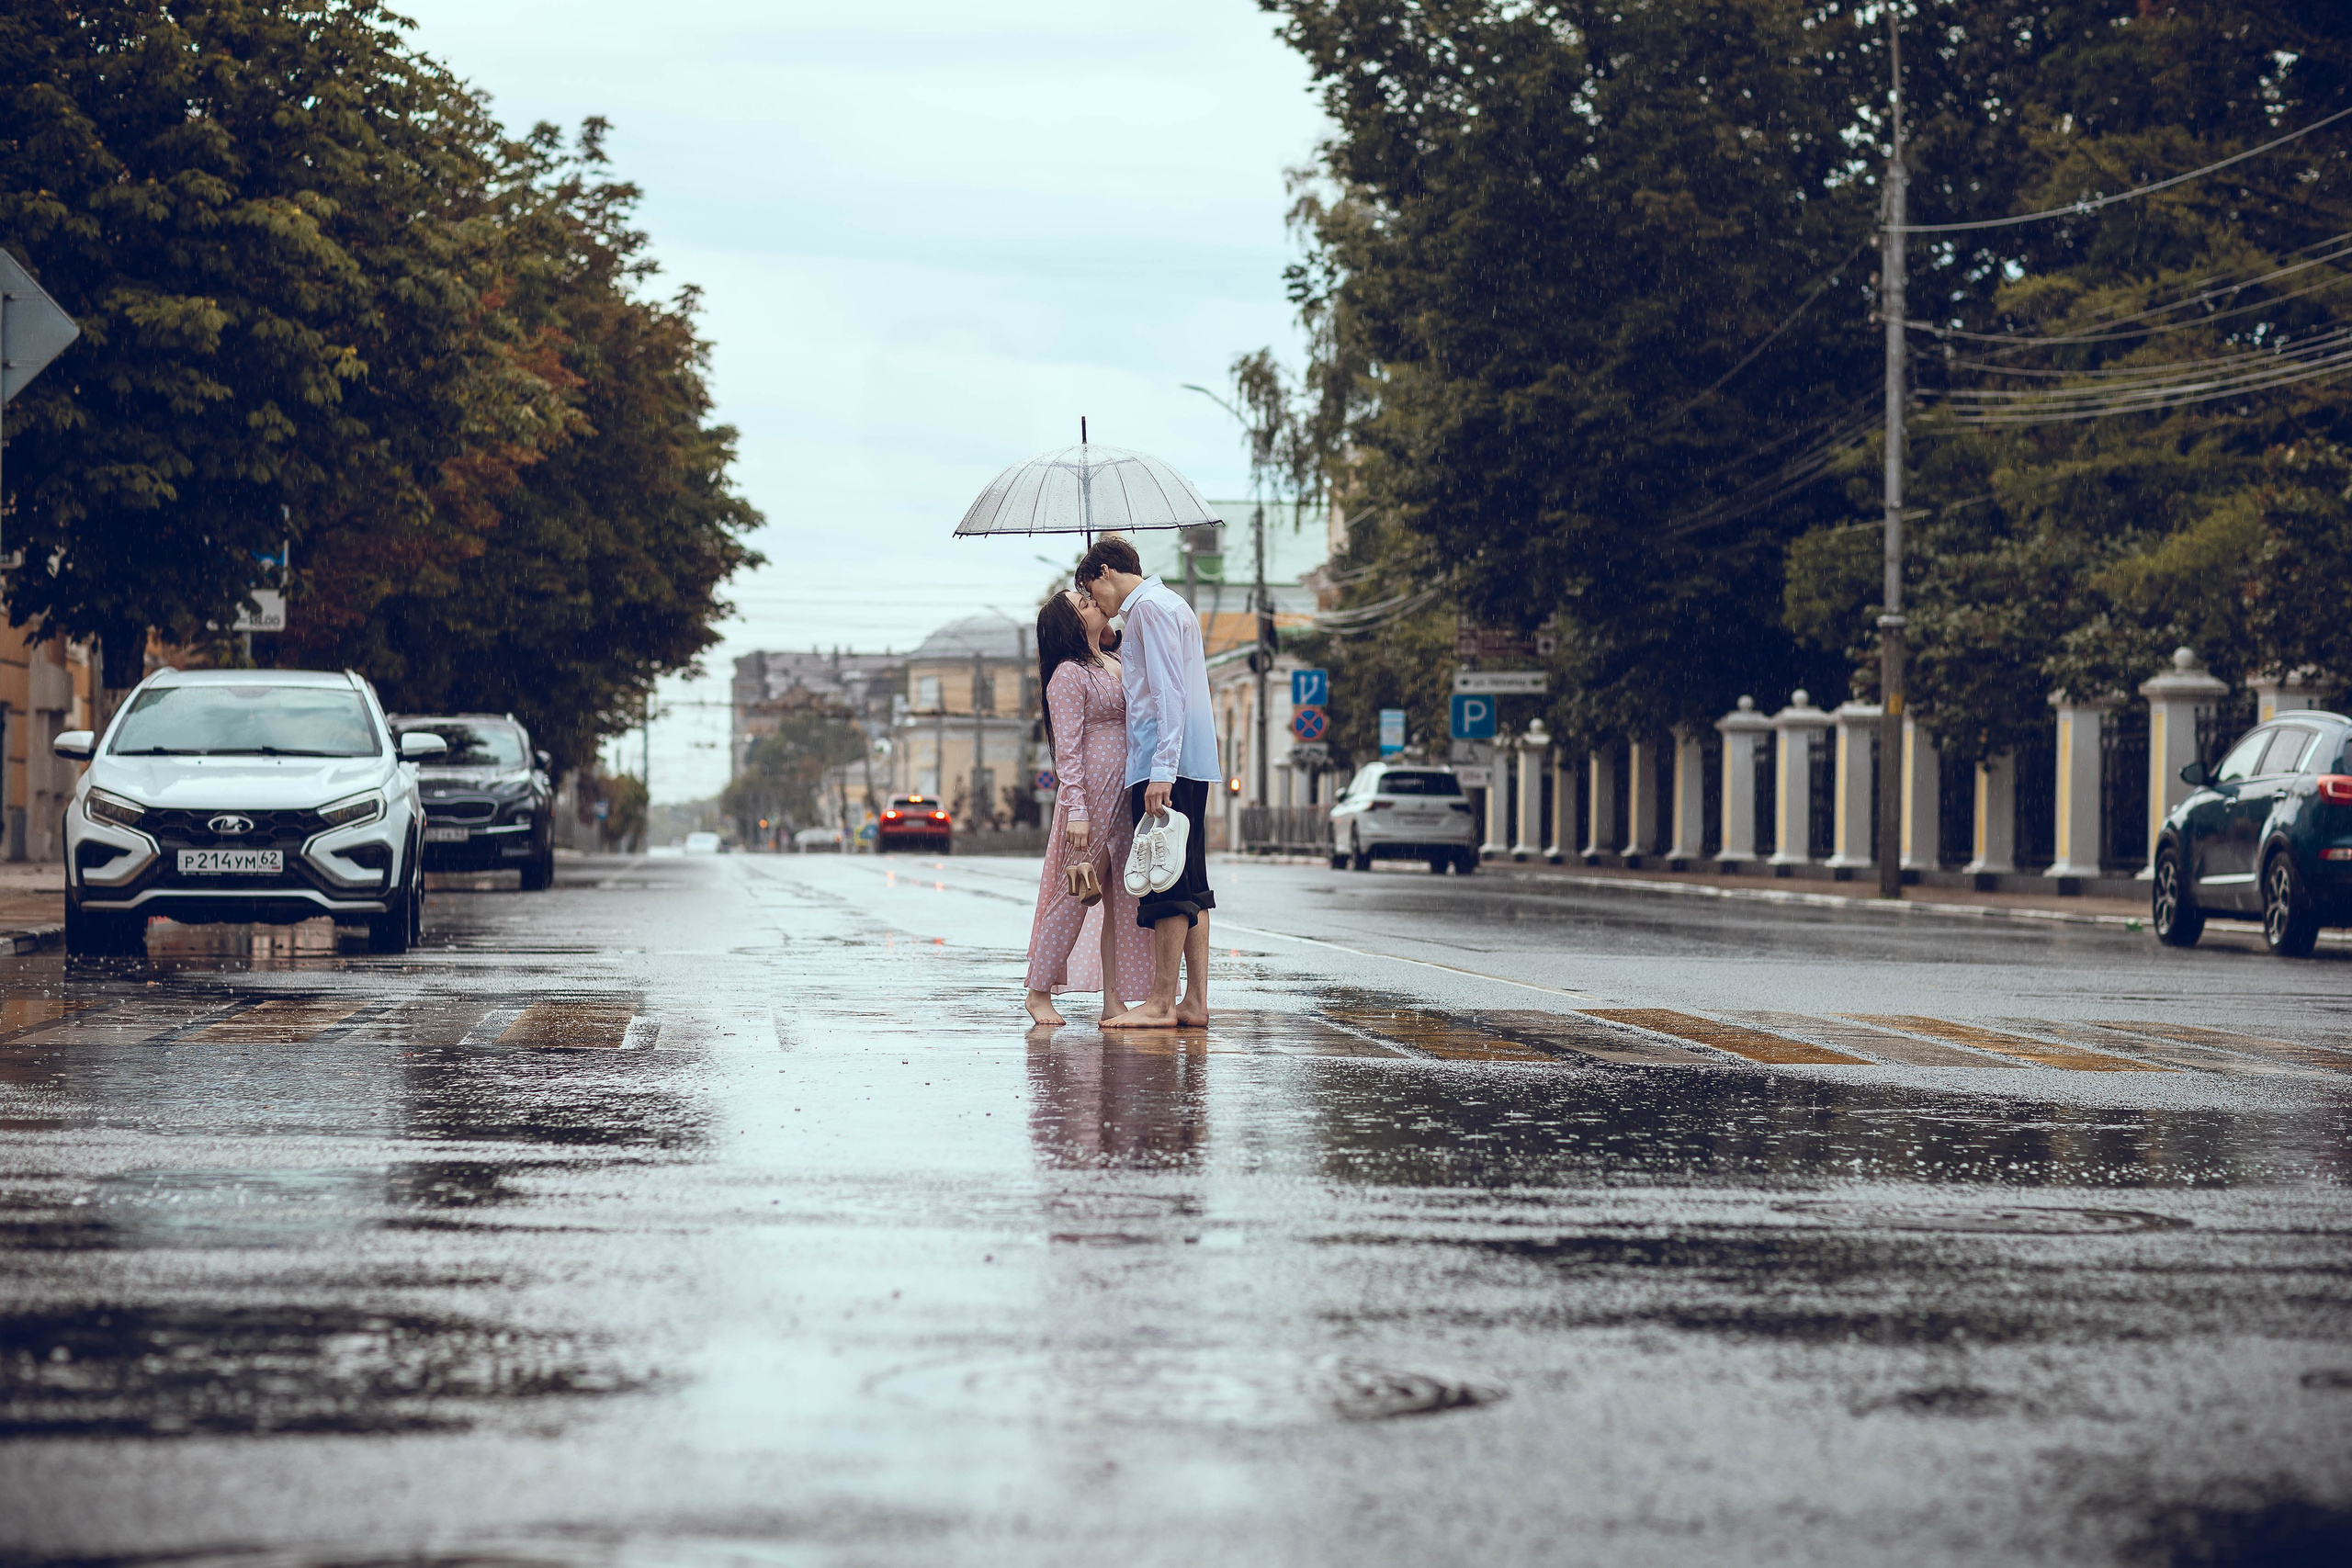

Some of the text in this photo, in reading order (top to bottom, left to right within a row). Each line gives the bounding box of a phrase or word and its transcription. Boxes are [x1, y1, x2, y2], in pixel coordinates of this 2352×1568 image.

[1464, 699, 1487, 733] P
[185, 852, 277, 869] Р214УМ 62
